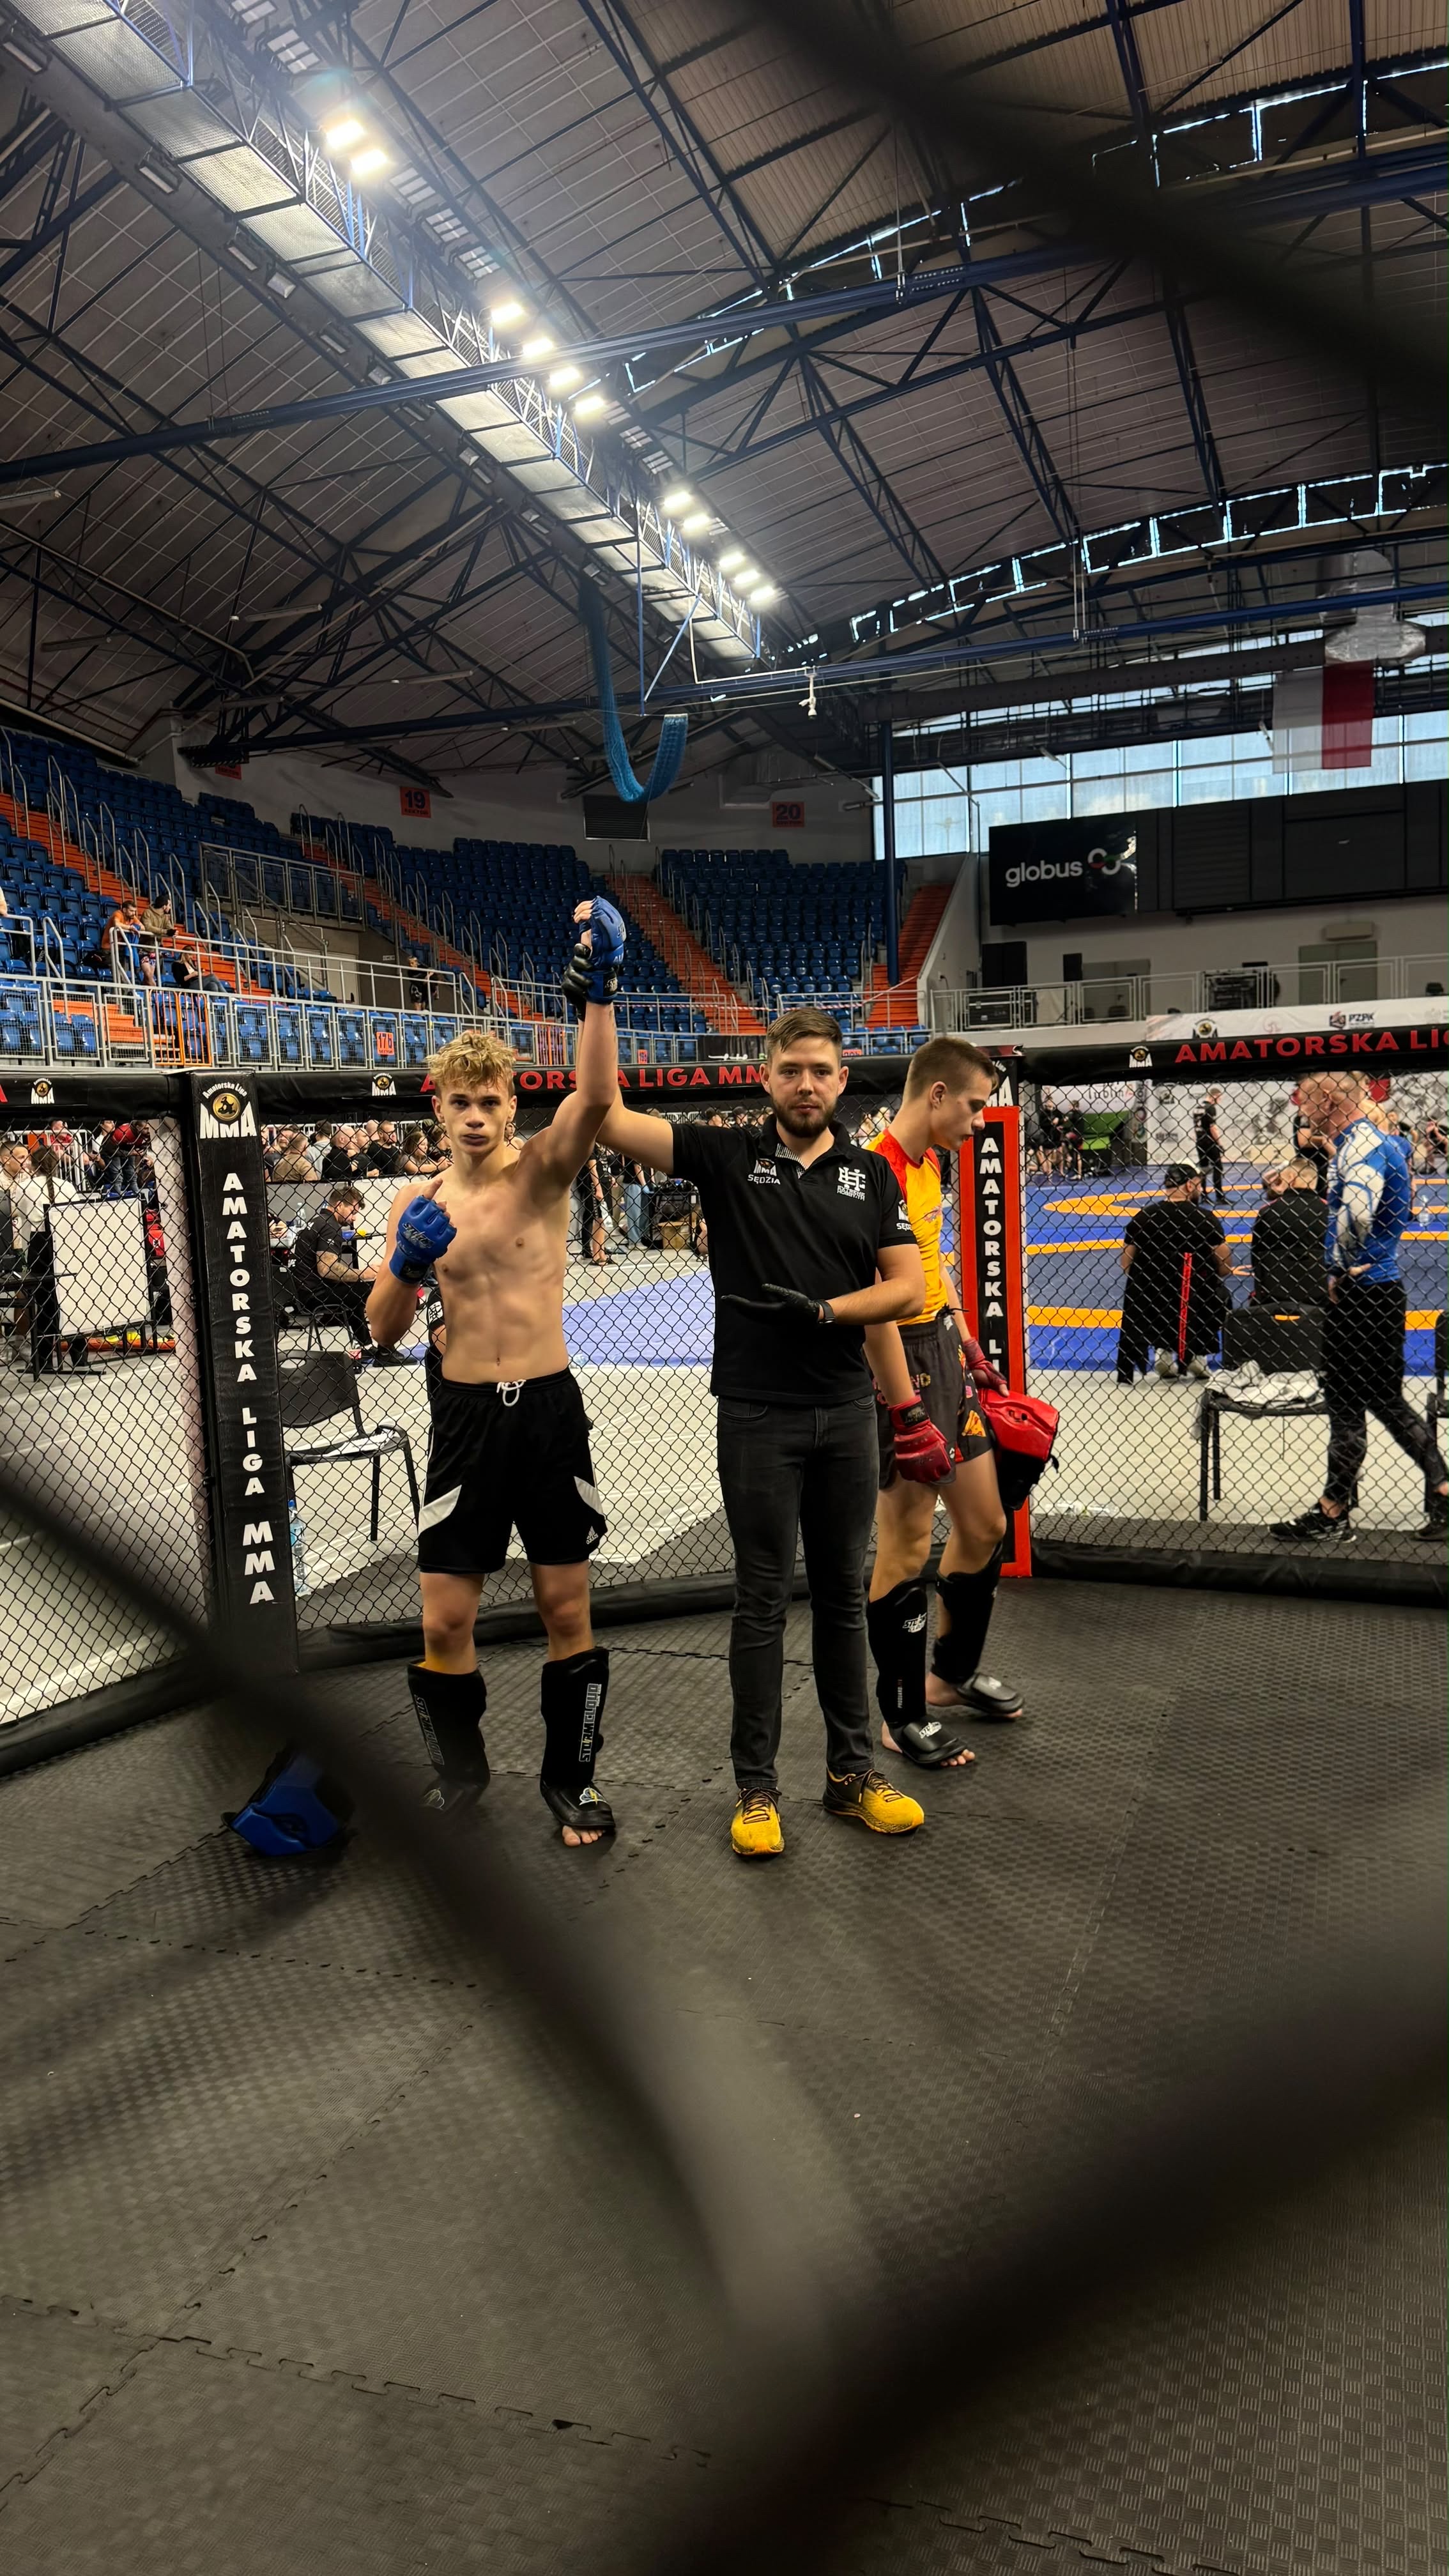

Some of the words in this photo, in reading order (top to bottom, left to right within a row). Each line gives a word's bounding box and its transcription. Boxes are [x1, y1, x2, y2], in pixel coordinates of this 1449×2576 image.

[405, 790, 425, 809] 19
[776, 804, 801, 820] 20
[1005, 860, 1083, 887] globus
[1174, 1032, 1399, 1063] AMATORSKA
[1410, 1028, 1449, 1050] LI
[1129, 1053, 1153, 1068] MMA
[640, 1067, 711, 1087] LIGA
[719, 1065, 762, 1084] MM
[31, 1087, 55, 1105] MMA
[202, 1082, 235, 1099] Amatorska
[372, 1080, 396, 1096] MMA
[199, 1101, 257, 1139] MMA
[747, 1174, 781, 1185] SĘDZIA
[979, 1137, 1004, 1317] AMATORSKA
[222, 1172, 257, 1383] AMATORSKA
[242, 1407, 265, 1496] LIGA
[243, 1521, 275, 1605] MMA
